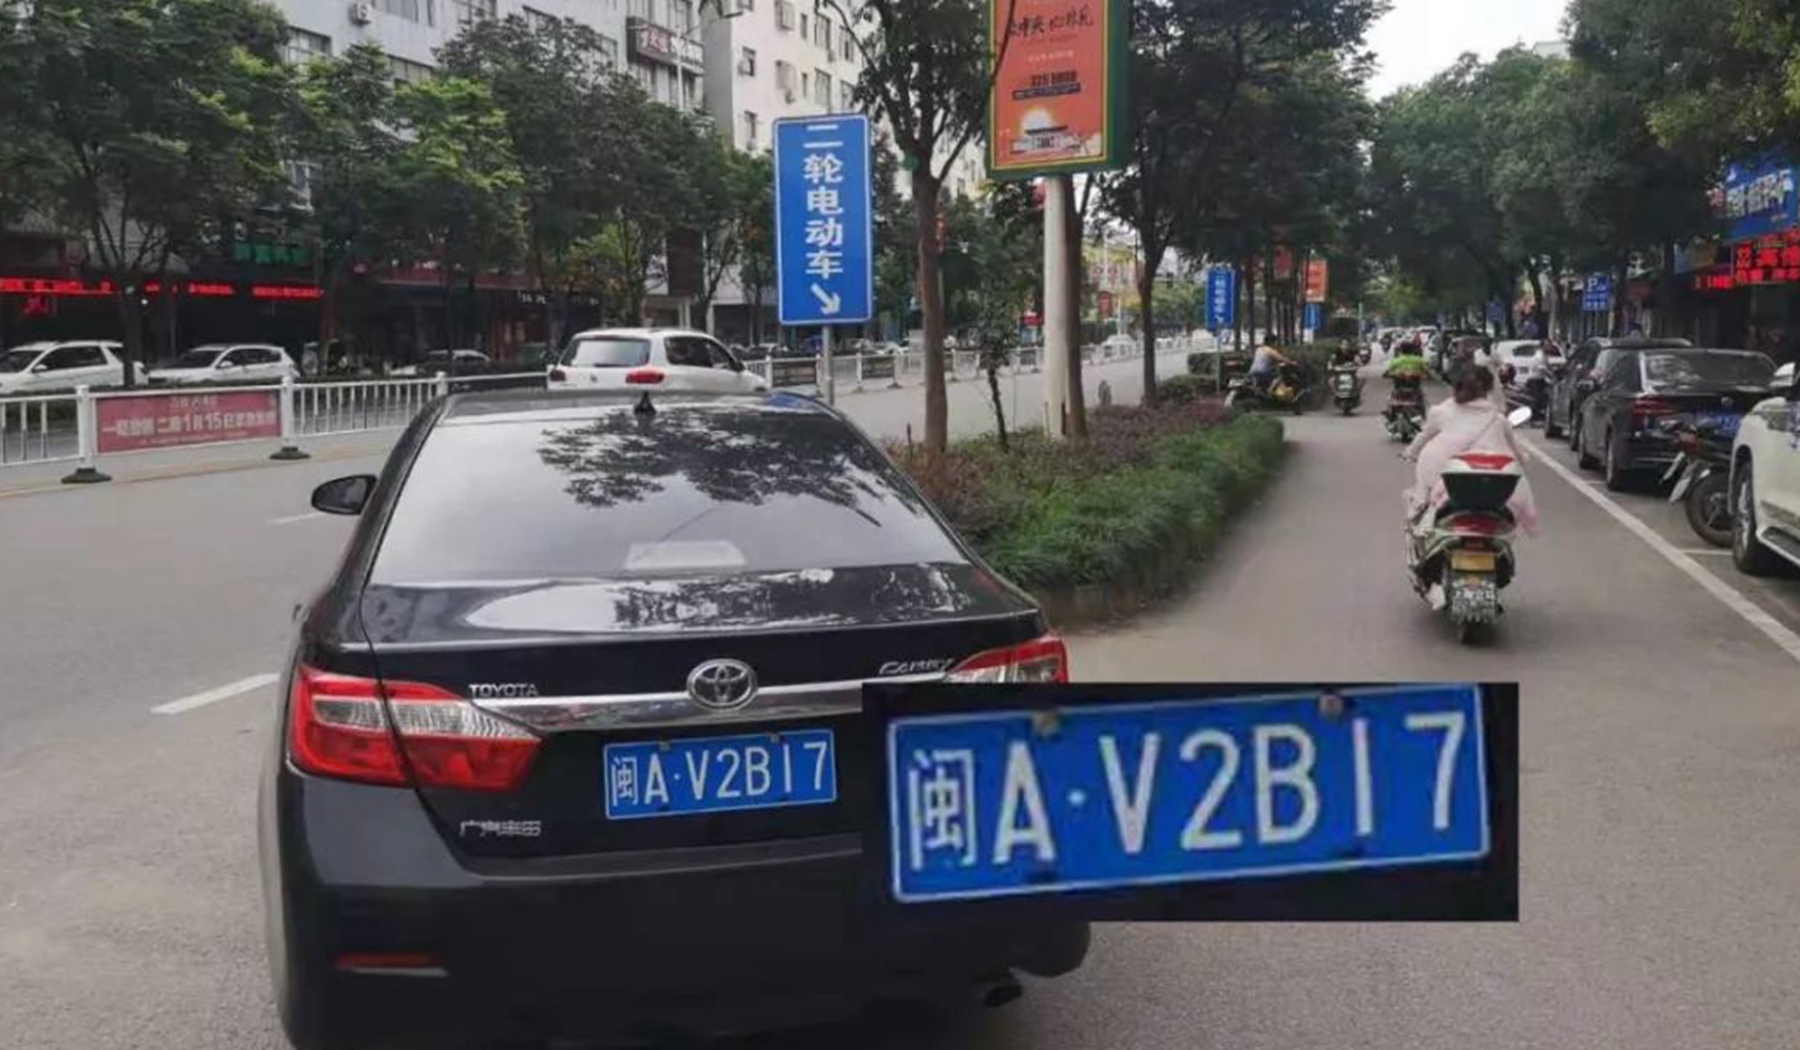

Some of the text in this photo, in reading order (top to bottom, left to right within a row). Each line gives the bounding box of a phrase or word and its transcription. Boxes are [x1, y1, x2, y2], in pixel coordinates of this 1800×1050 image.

[803, 124, 844, 280] 二轮电动车
[469, 683, 538, 697] TOYOTA
[611, 741, 828, 807] 闽A·V2B17
